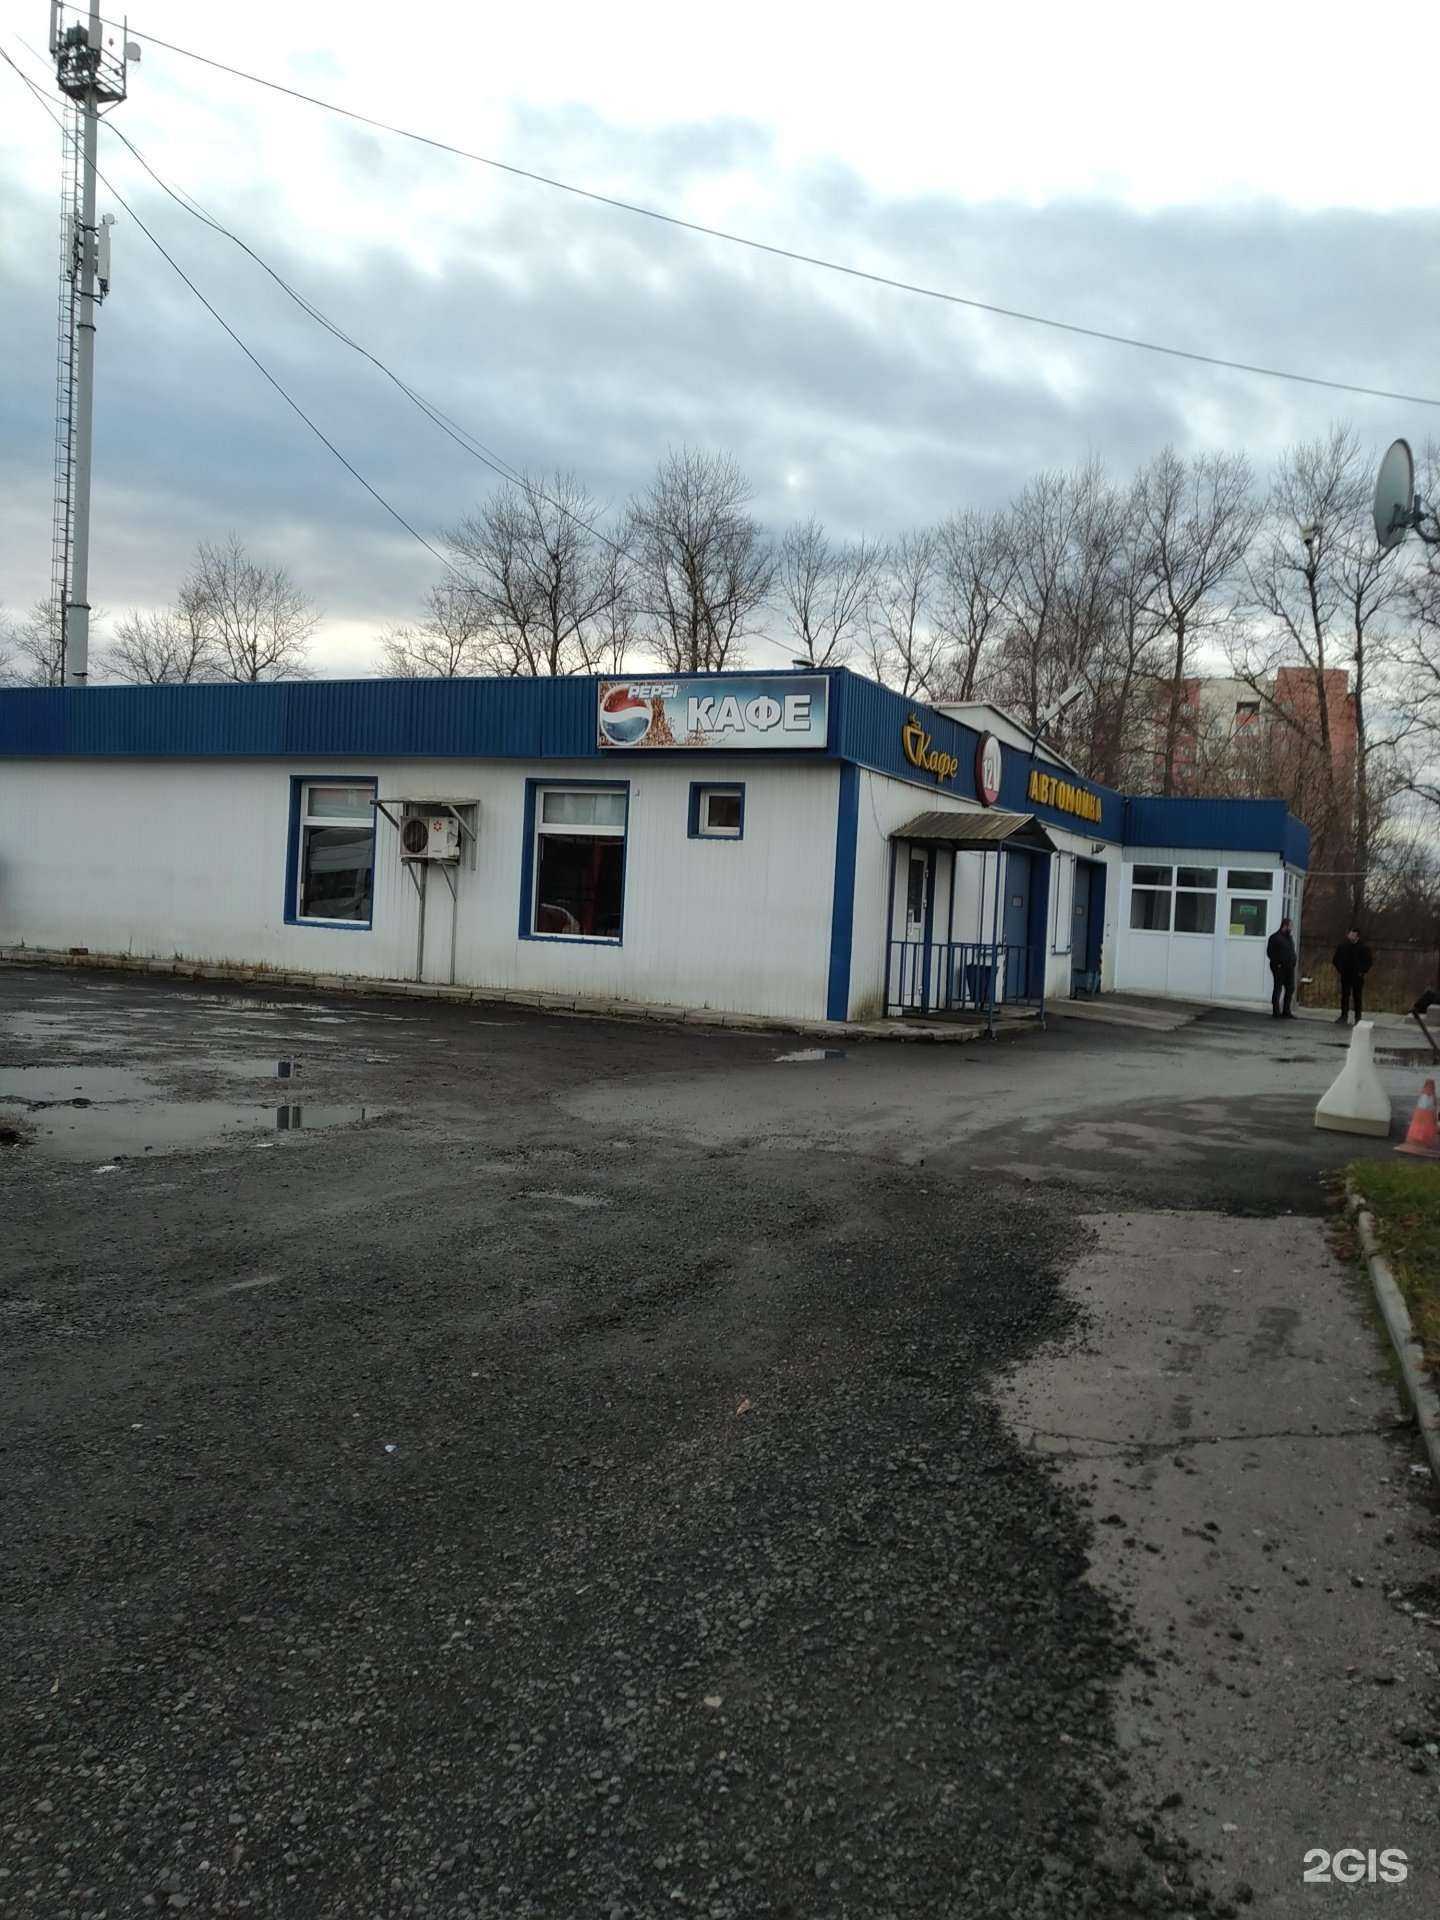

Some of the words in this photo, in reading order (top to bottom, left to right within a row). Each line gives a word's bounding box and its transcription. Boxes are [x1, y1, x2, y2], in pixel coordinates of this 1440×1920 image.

[628, 684, 679, 699] PEPSI
[687, 694, 811, 732] КАФЕ
[1029, 770, 1102, 823] АВТОМОЙКА
